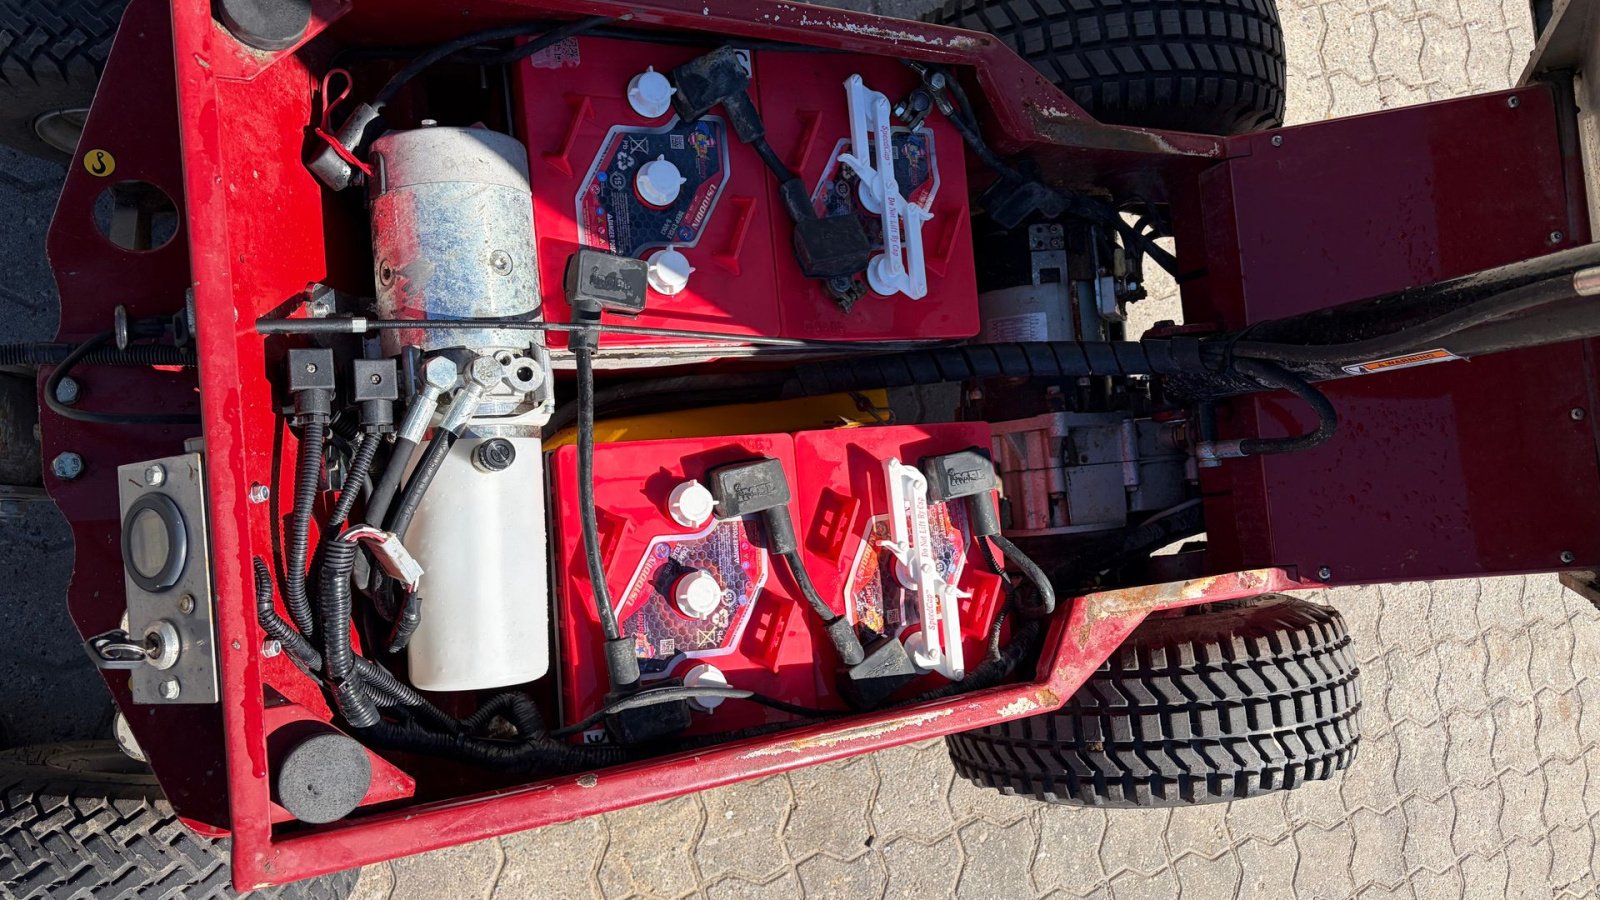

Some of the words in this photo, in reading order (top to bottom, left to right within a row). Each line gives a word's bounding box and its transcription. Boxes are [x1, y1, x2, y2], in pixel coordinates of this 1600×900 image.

[889, 207, 897, 217] Not
[890, 220, 898, 233] Lift
[892, 244, 900, 257] Cap
[916, 496, 926, 510] Cap
[918, 521, 927, 534] Lift
